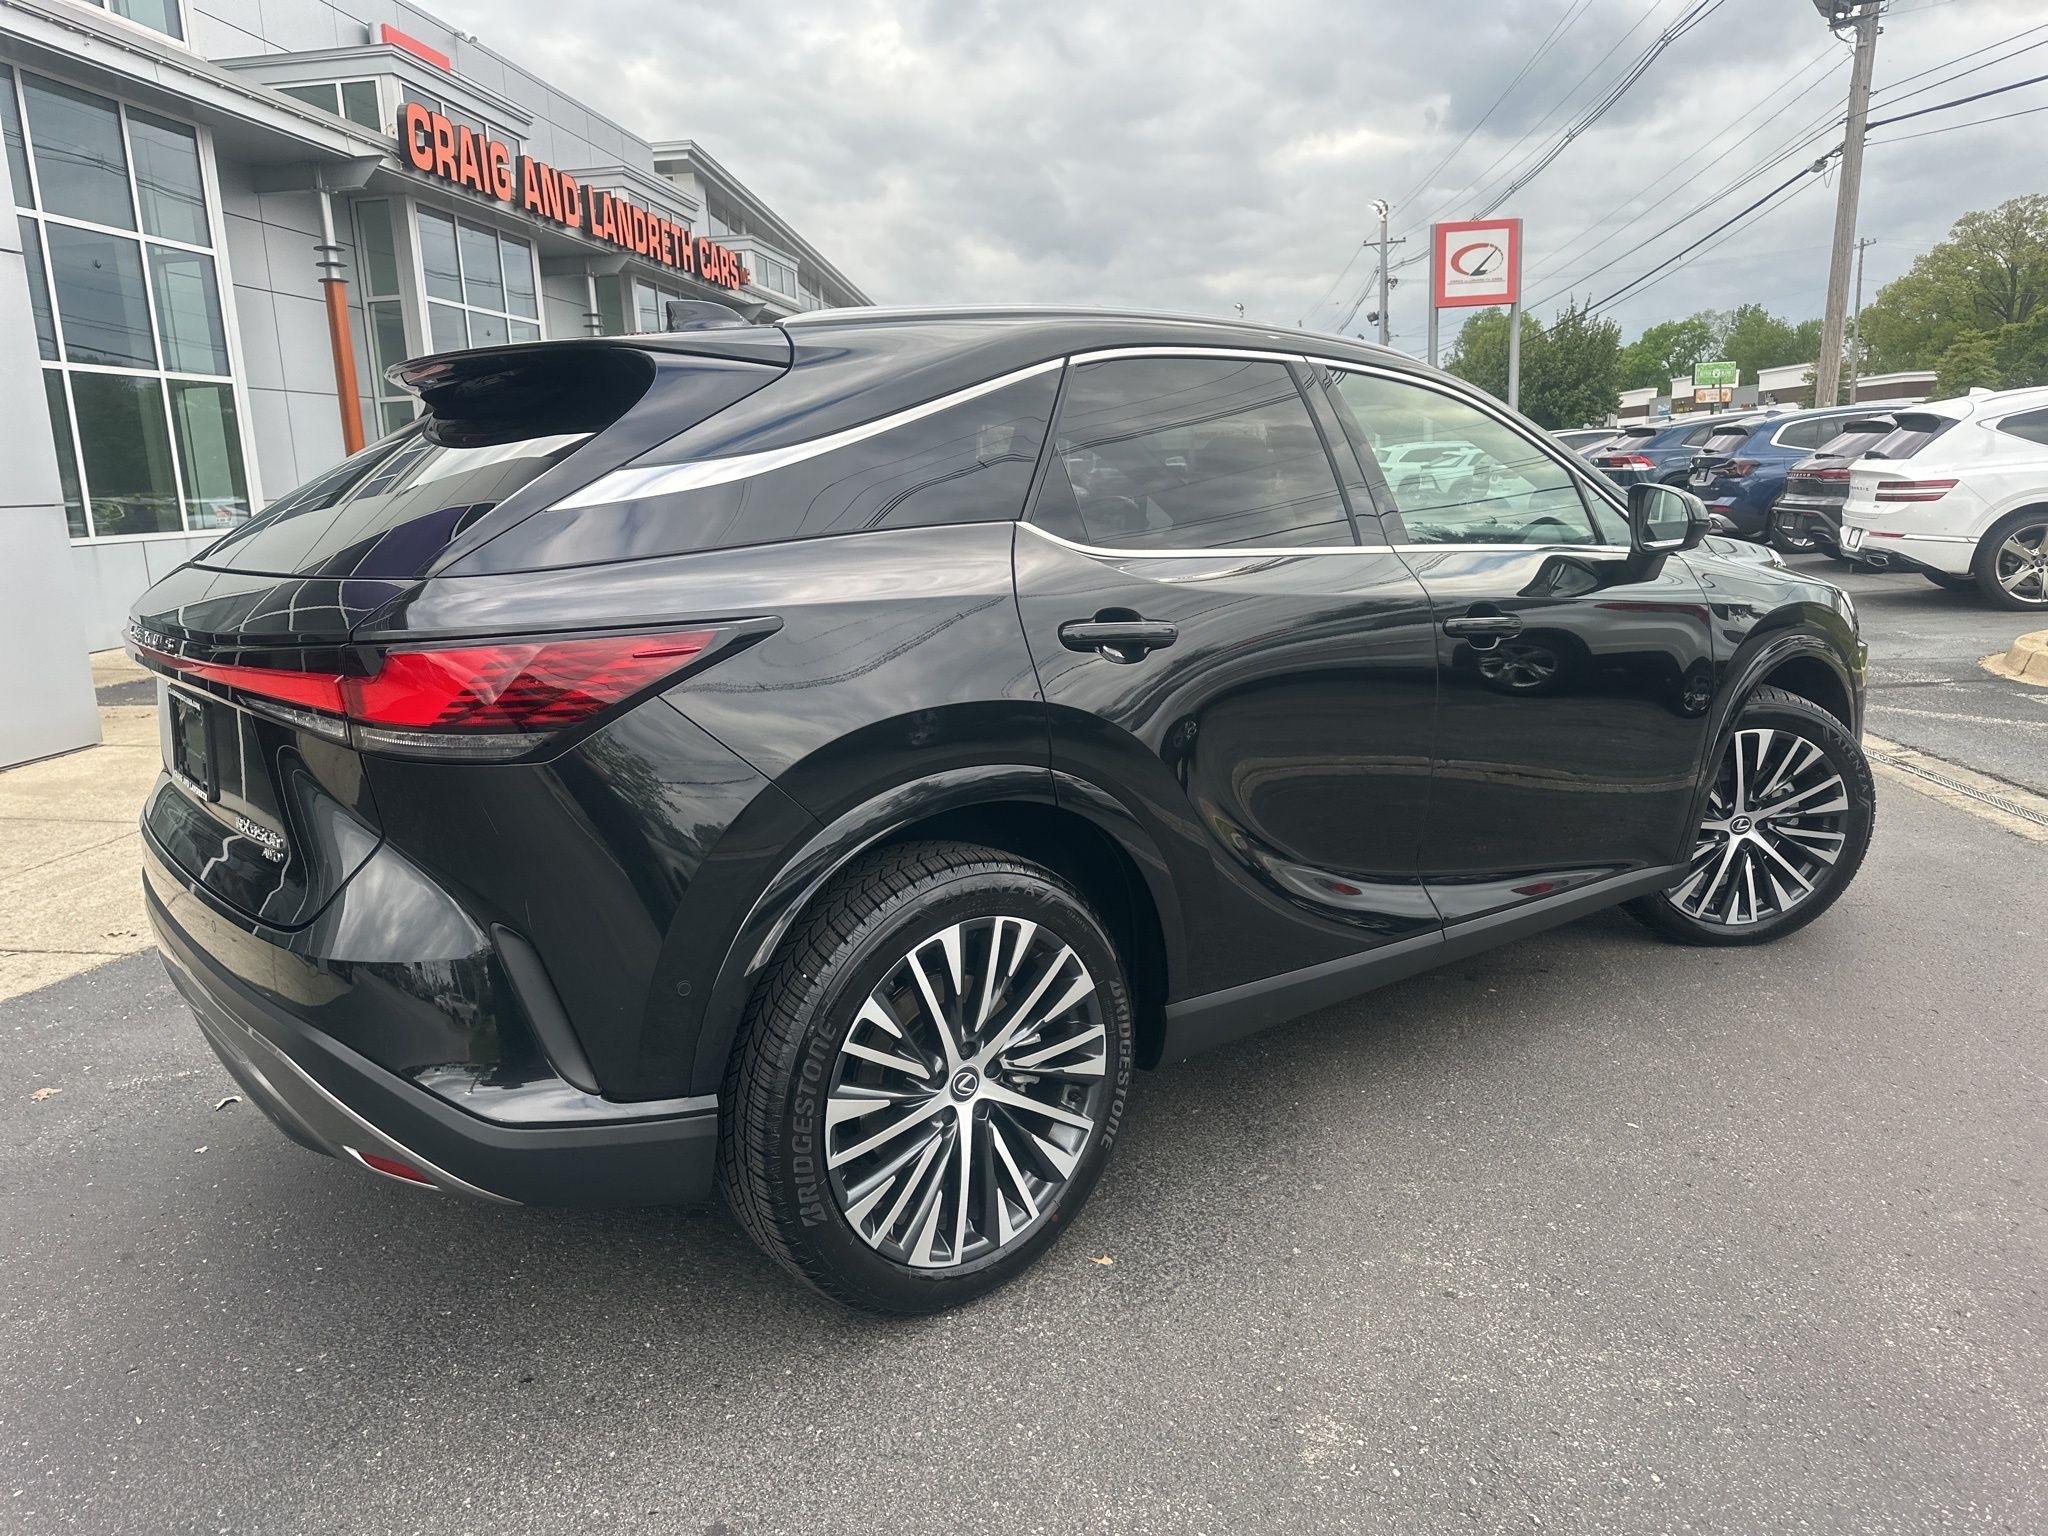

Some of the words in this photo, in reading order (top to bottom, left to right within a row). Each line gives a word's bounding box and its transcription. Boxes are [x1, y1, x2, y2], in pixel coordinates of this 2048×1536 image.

[405, 101, 512, 202] CRAIG
[522, 155, 580, 228] AND
[587, 184, 695, 274] LANDRETH
[698, 236, 740, 291] CARS
[792, 1015, 837, 1227] BRIDGESTONE
[1101, 976, 1133, 1150] BRIDGESTONE
